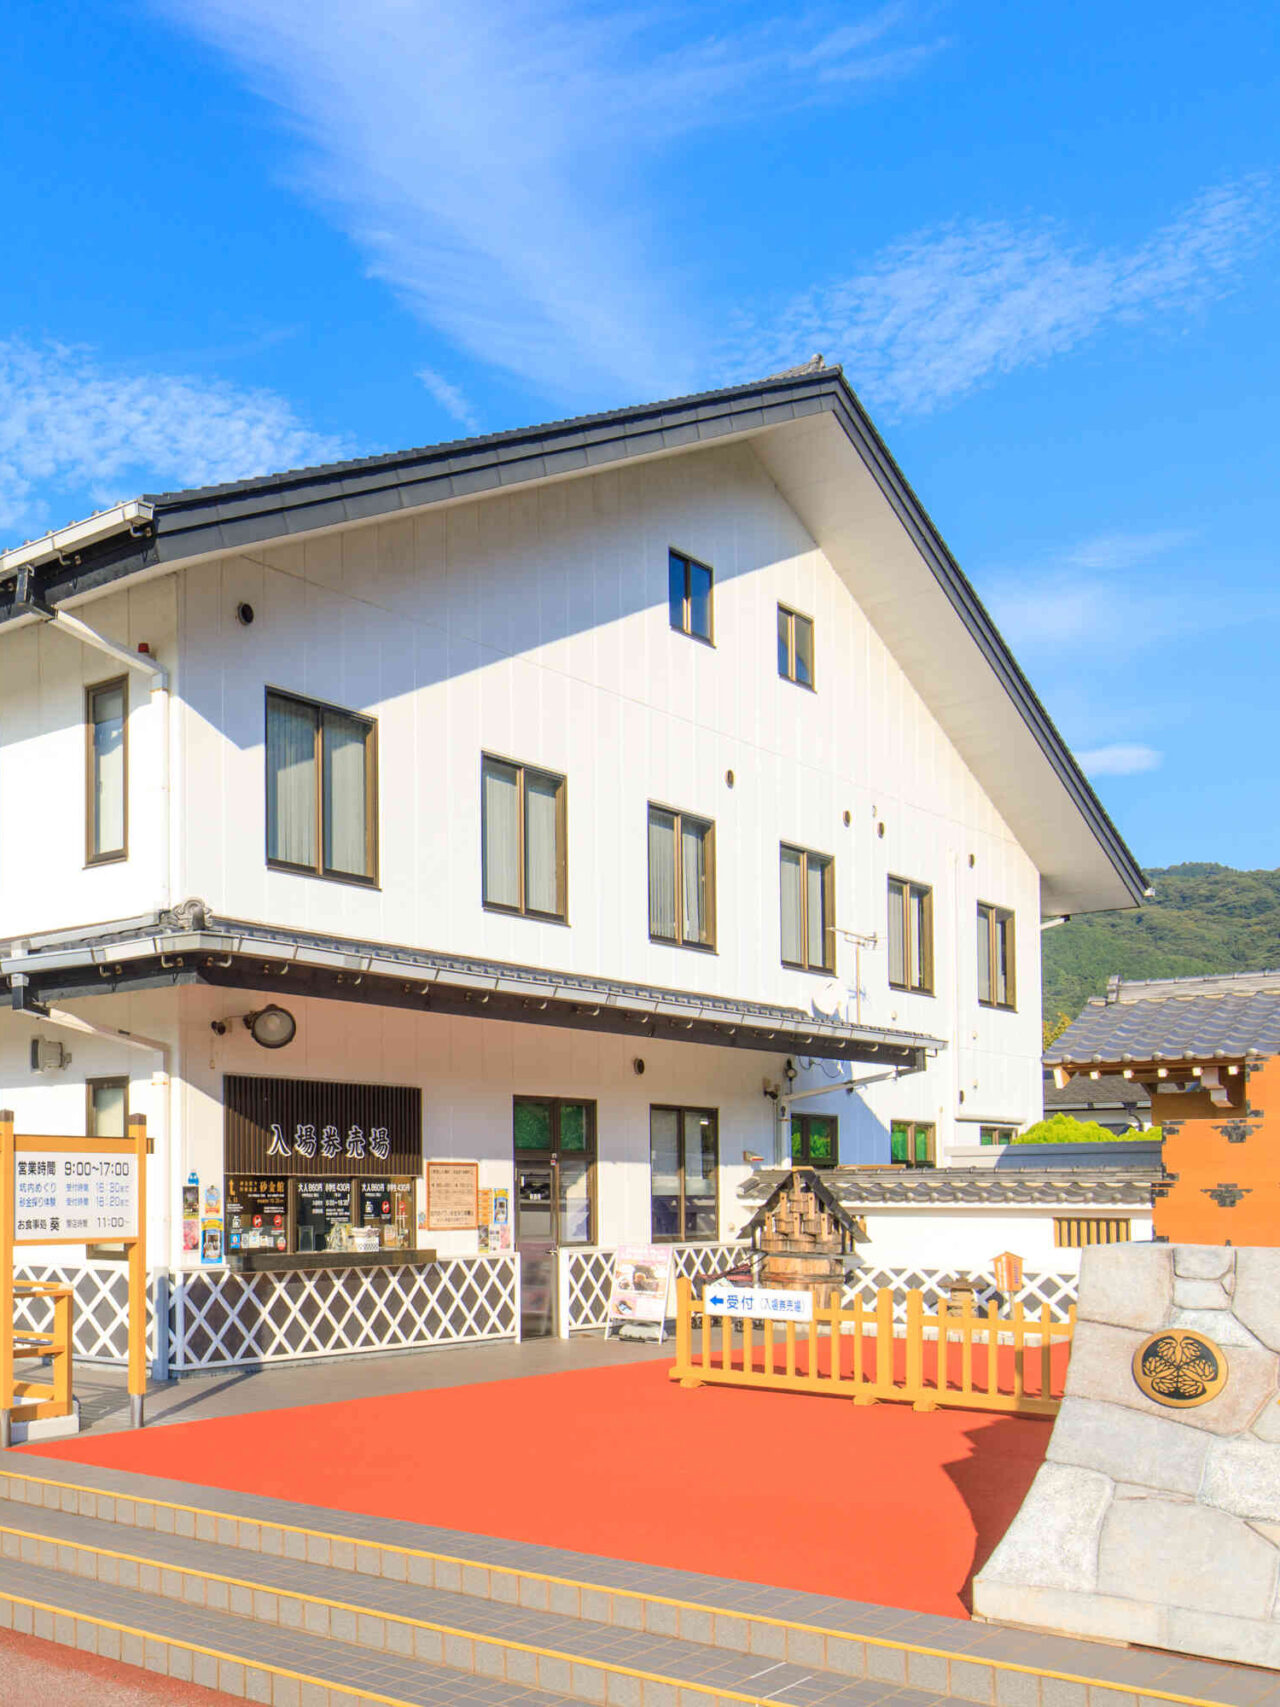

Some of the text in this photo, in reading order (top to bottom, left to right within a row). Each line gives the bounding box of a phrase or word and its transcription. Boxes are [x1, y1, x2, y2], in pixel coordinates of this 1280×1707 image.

[268, 1123, 391, 1160] 入場券売場
[18, 1161, 56, 1176] 営業時間
[18, 1219, 47, 1230] お食事処
[726, 1294, 754, 1311] 受付
